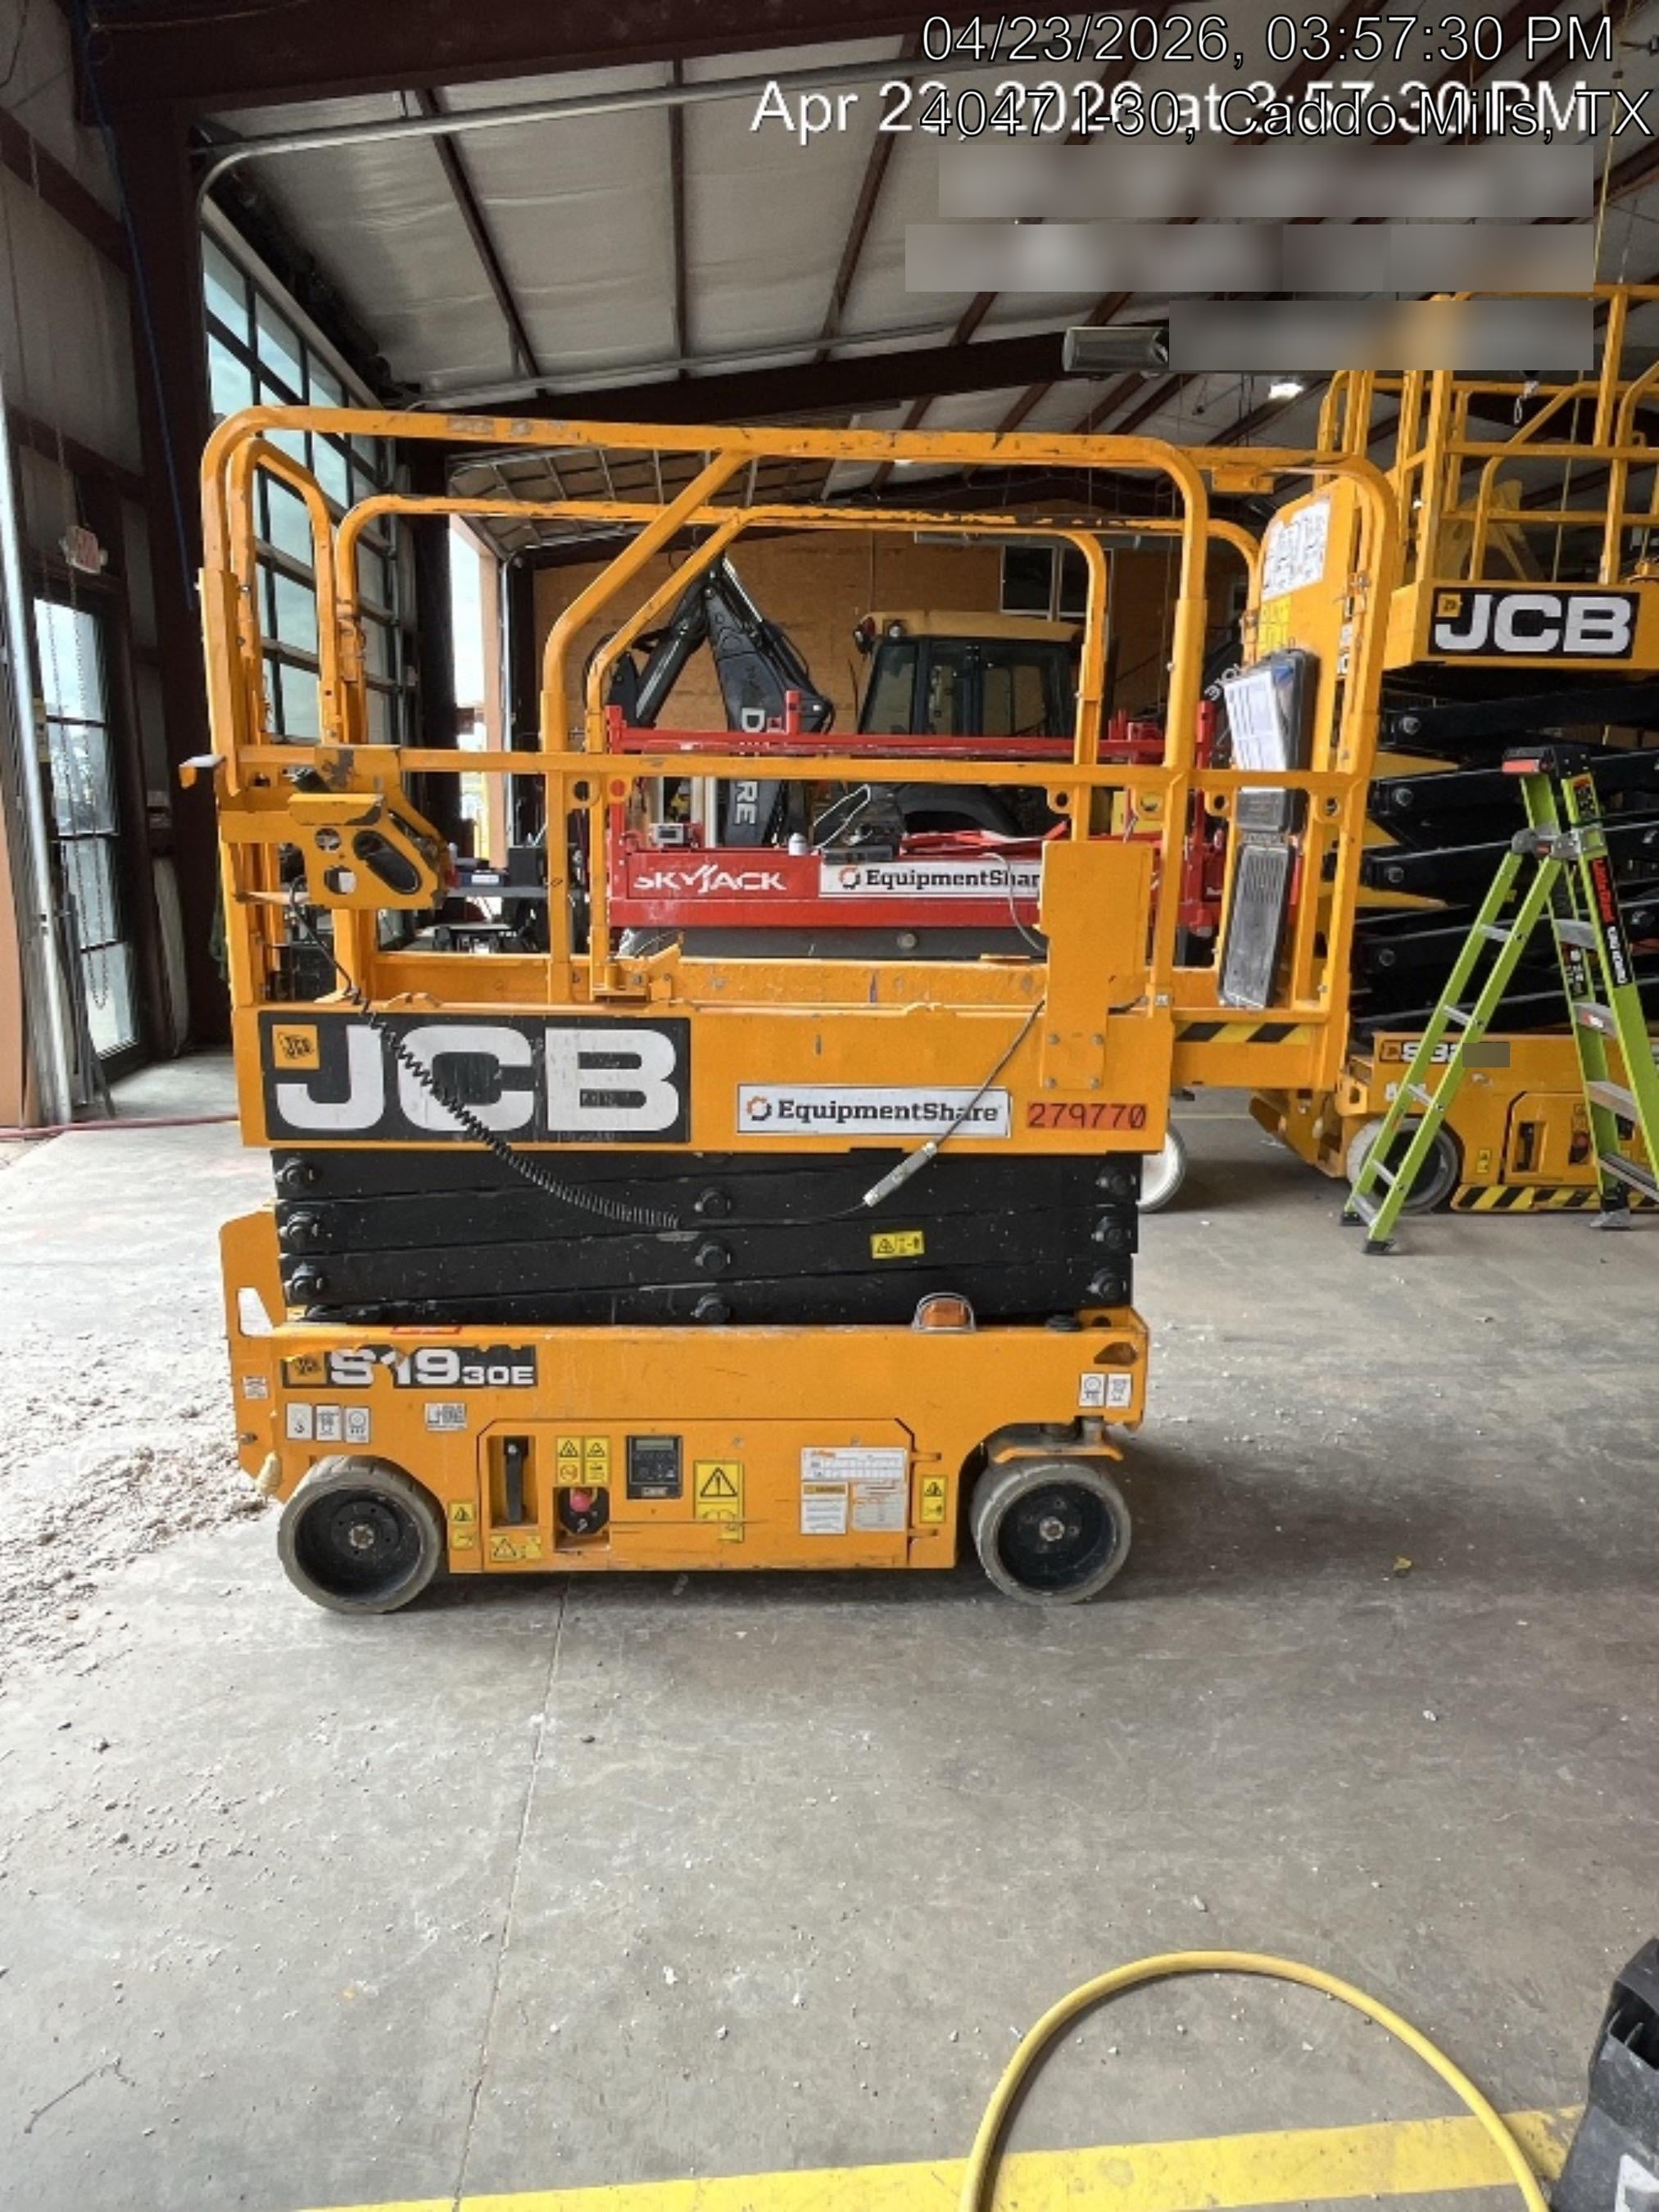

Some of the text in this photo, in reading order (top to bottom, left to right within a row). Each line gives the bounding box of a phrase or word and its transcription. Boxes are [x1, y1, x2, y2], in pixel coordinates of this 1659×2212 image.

[1435, 594, 1631, 654] JCB
[735, 707, 765, 824] DRE
[633, 864, 787, 894] SKYJACK
[865, 868, 1040, 891] EquipmentShar
[274, 1024, 680, 1131] JCB
[777, 1099, 999, 1123] EquipmentShare
[1028, 1102, 1146, 1130] 279770
